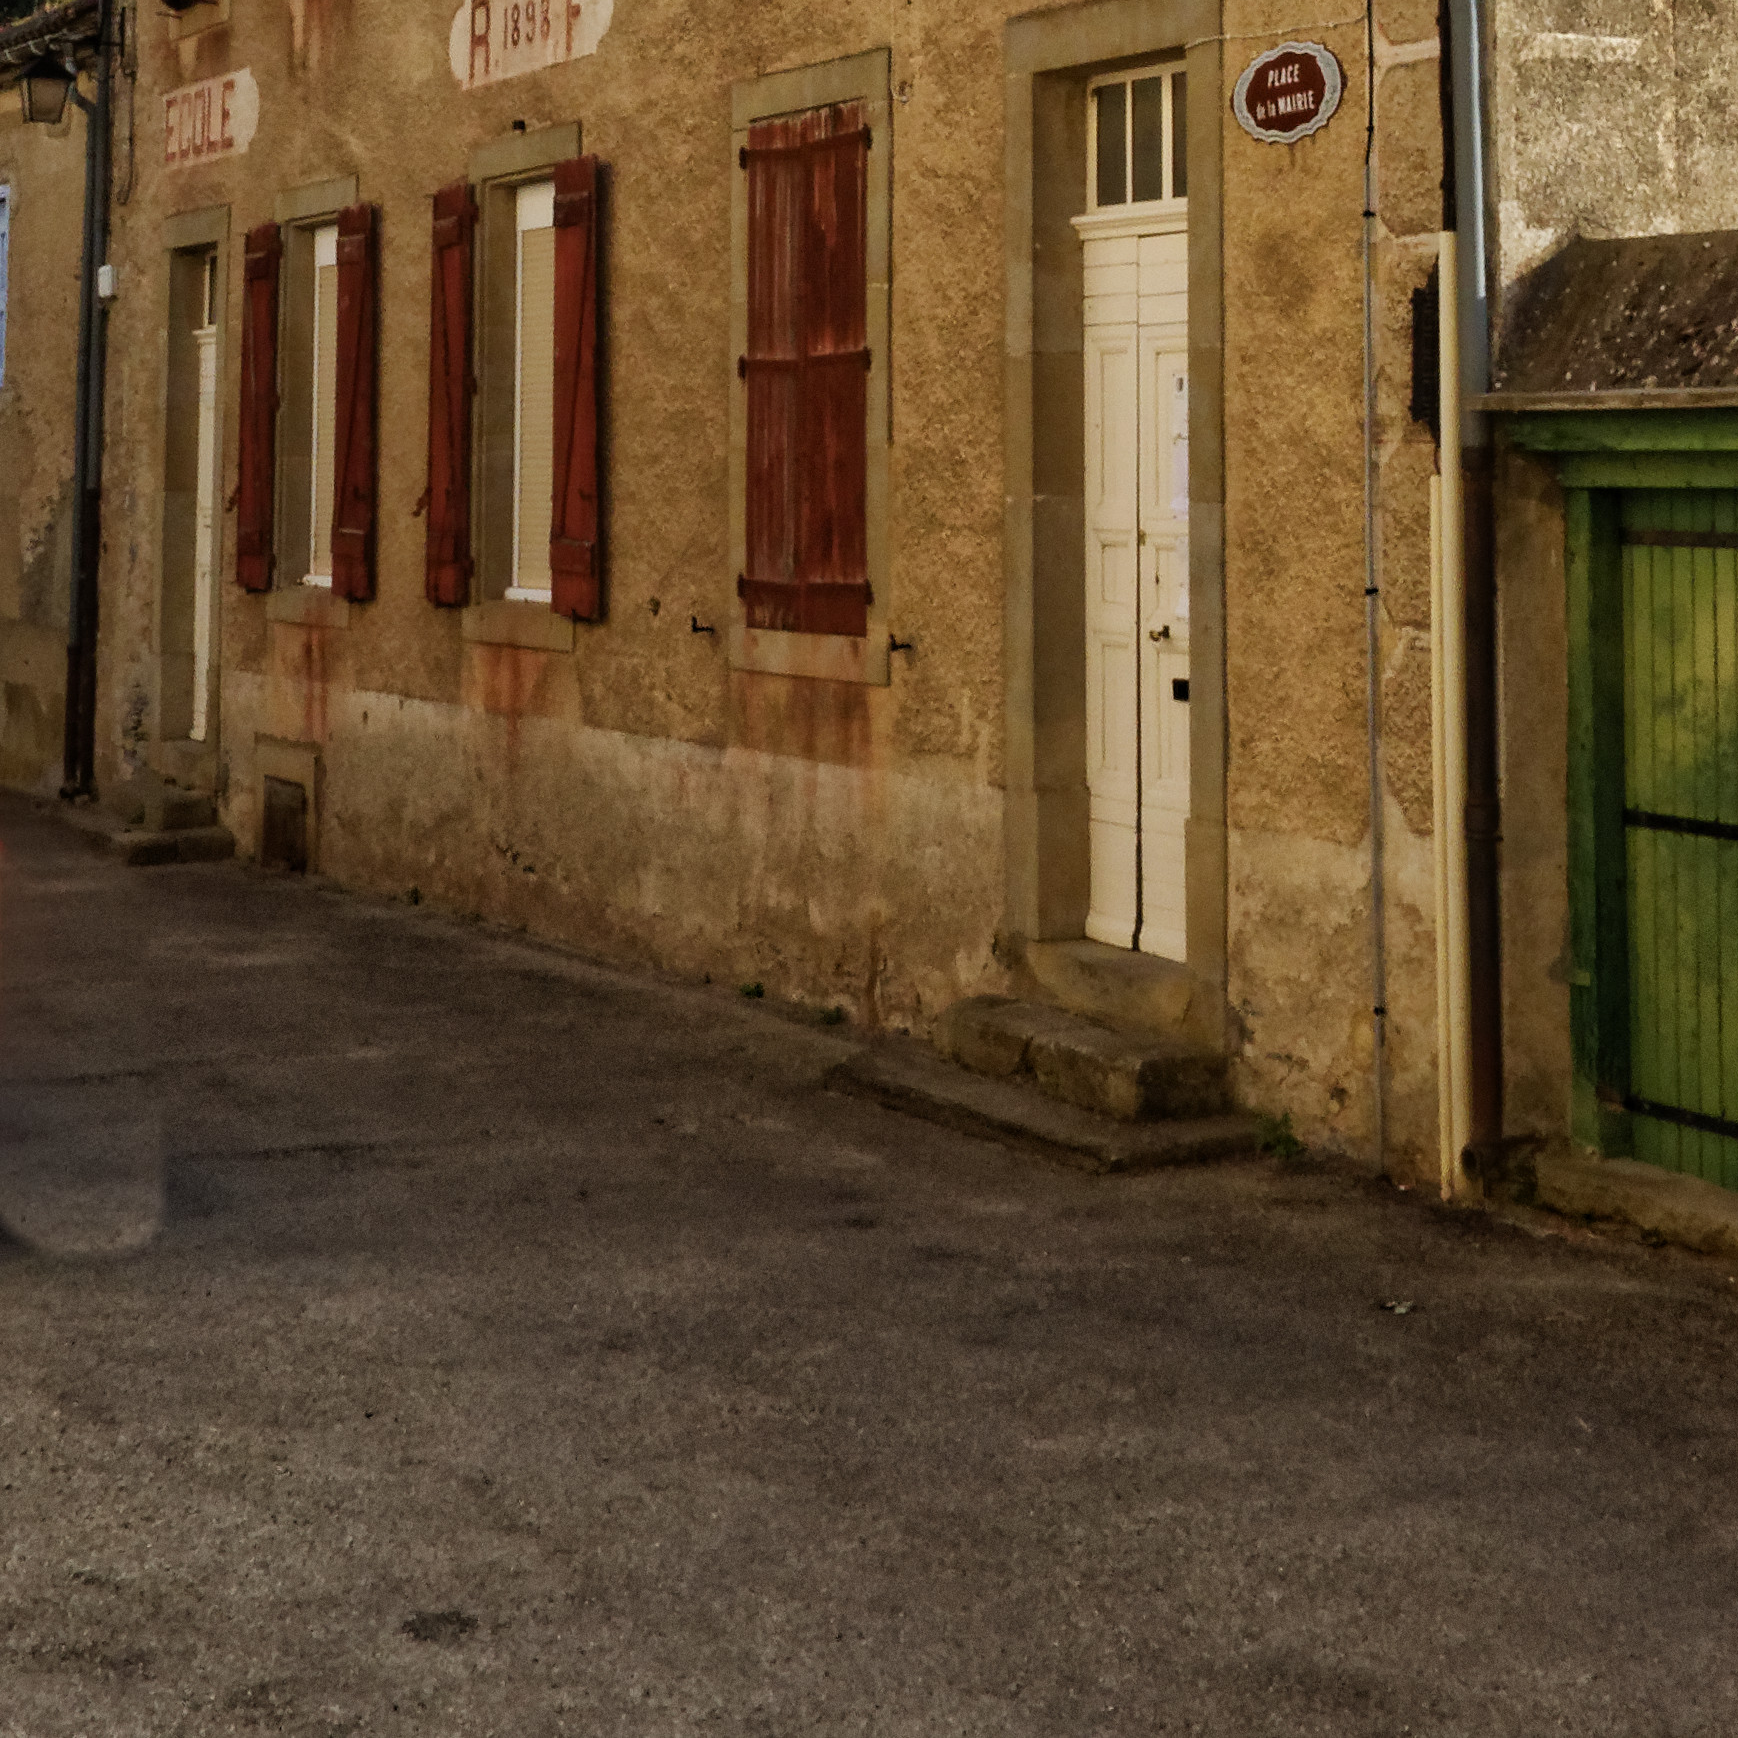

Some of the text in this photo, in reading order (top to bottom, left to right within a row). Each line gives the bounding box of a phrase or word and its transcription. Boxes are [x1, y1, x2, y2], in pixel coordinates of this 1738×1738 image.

[1267, 63, 1299, 88] PLACE
[1278, 90, 1315, 114] MAIRIE
[165, 79, 235, 161] ECOLE
